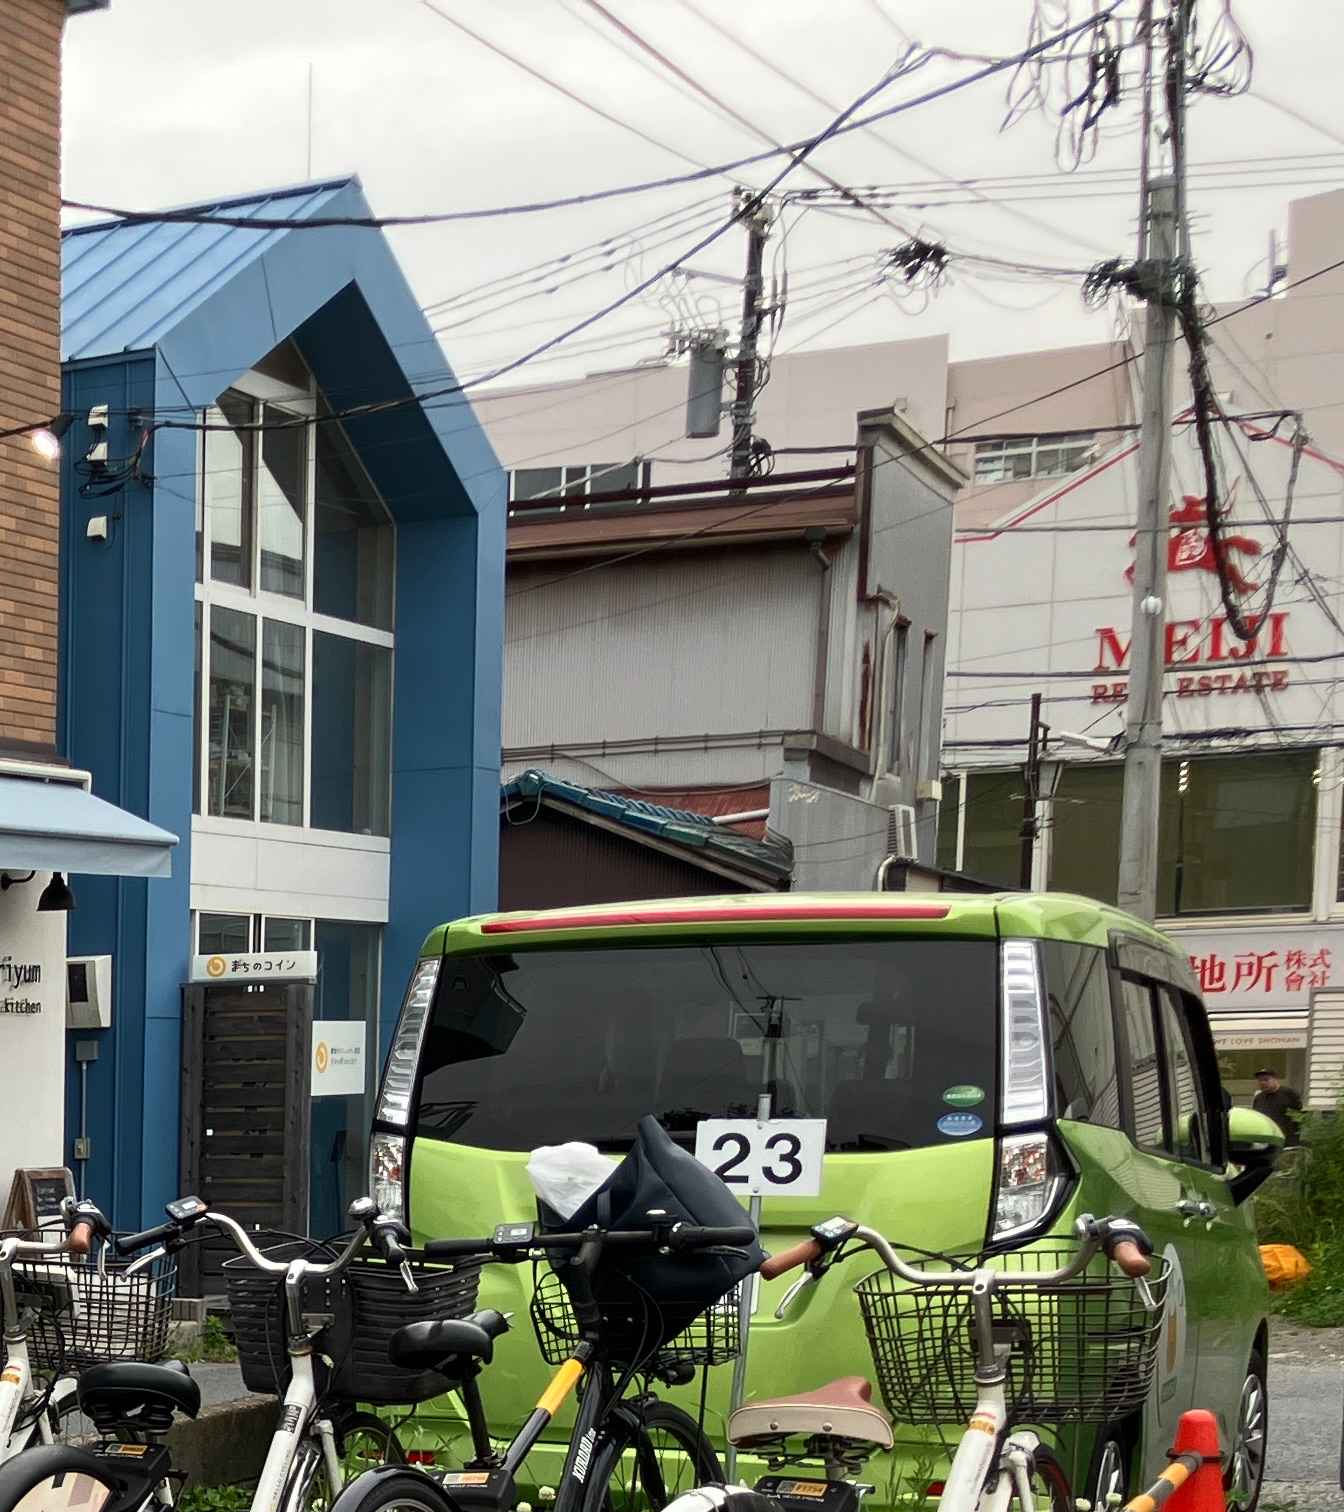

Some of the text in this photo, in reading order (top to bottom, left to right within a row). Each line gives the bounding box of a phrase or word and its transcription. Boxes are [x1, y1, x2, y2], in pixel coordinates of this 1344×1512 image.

[1094, 611, 1290, 672] MEIJI
[1176, 670, 1289, 698] ESTATE
[231, 959, 296, 973] まちのコイン
[712, 1132, 802, 1184] 23
